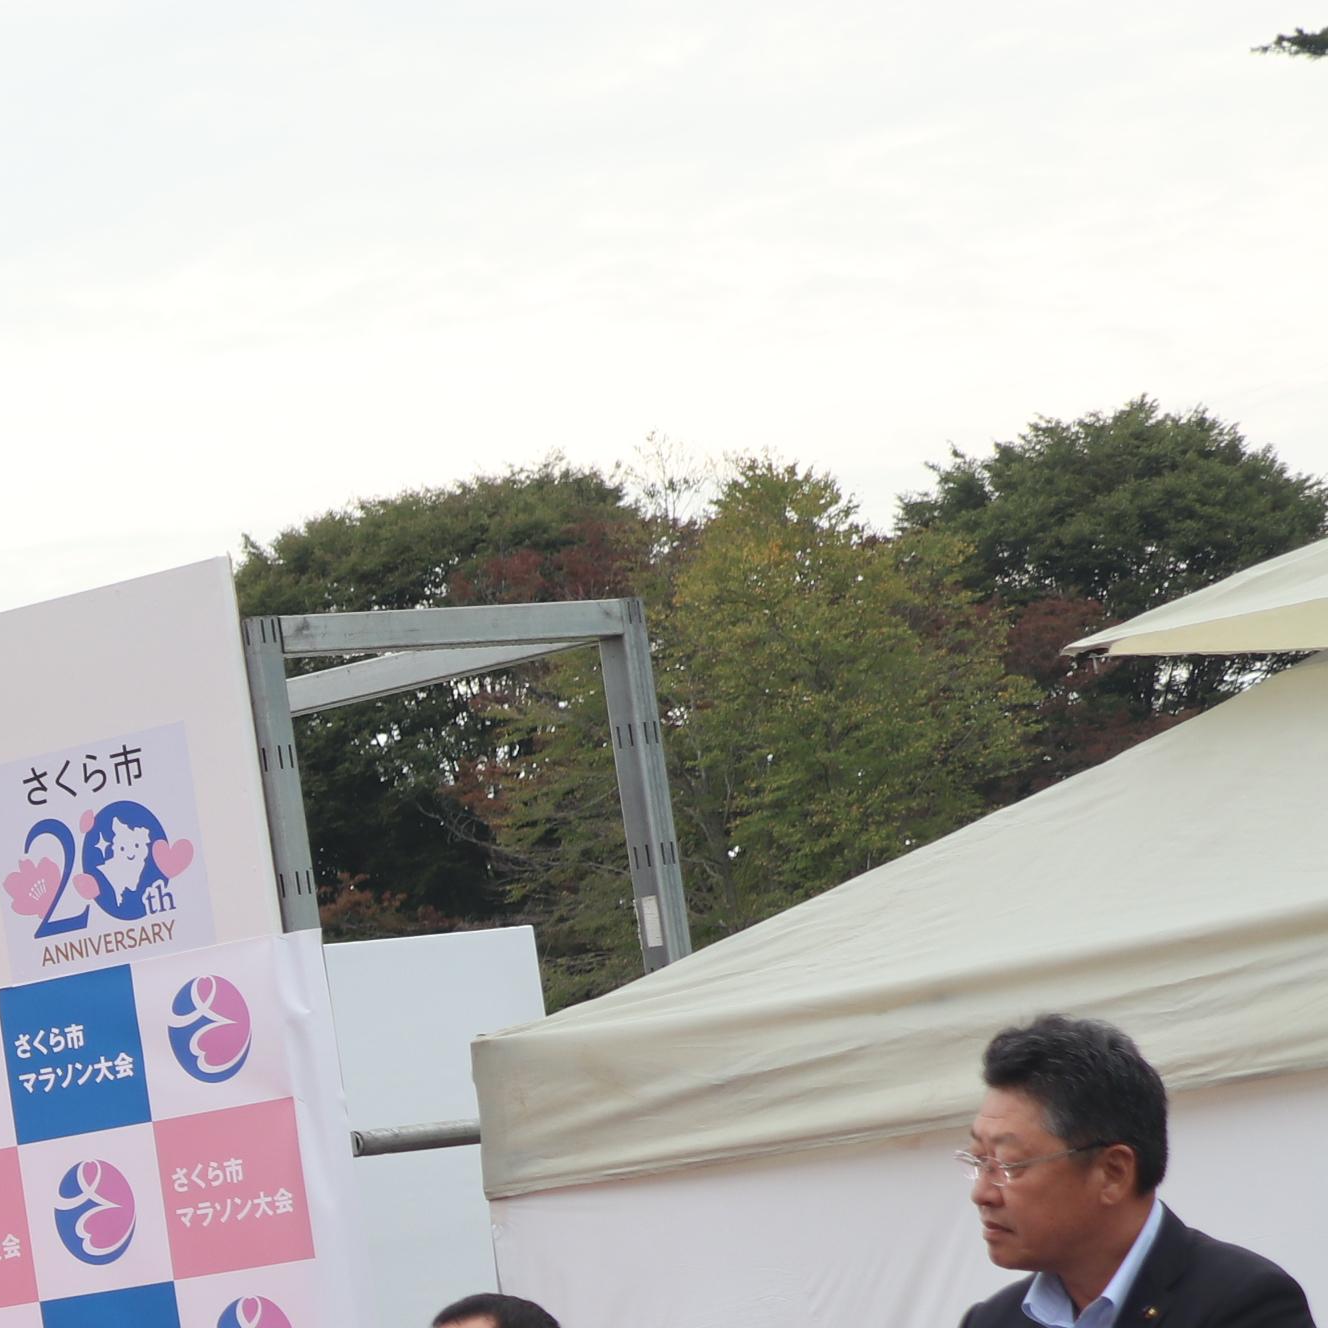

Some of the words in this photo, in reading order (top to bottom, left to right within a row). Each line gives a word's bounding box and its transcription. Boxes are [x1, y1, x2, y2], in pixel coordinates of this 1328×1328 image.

[22, 744, 143, 806] さくら市
[41, 919, 176, 967] ANNIVERSARY
[15, 1023, 85, 1059] さくら市
[18, 1052, 134, 1093] マラソン大会
[171, 1158, 245, 1193] さくら市
[176, 1187, 294, 1227] マラソン大会
